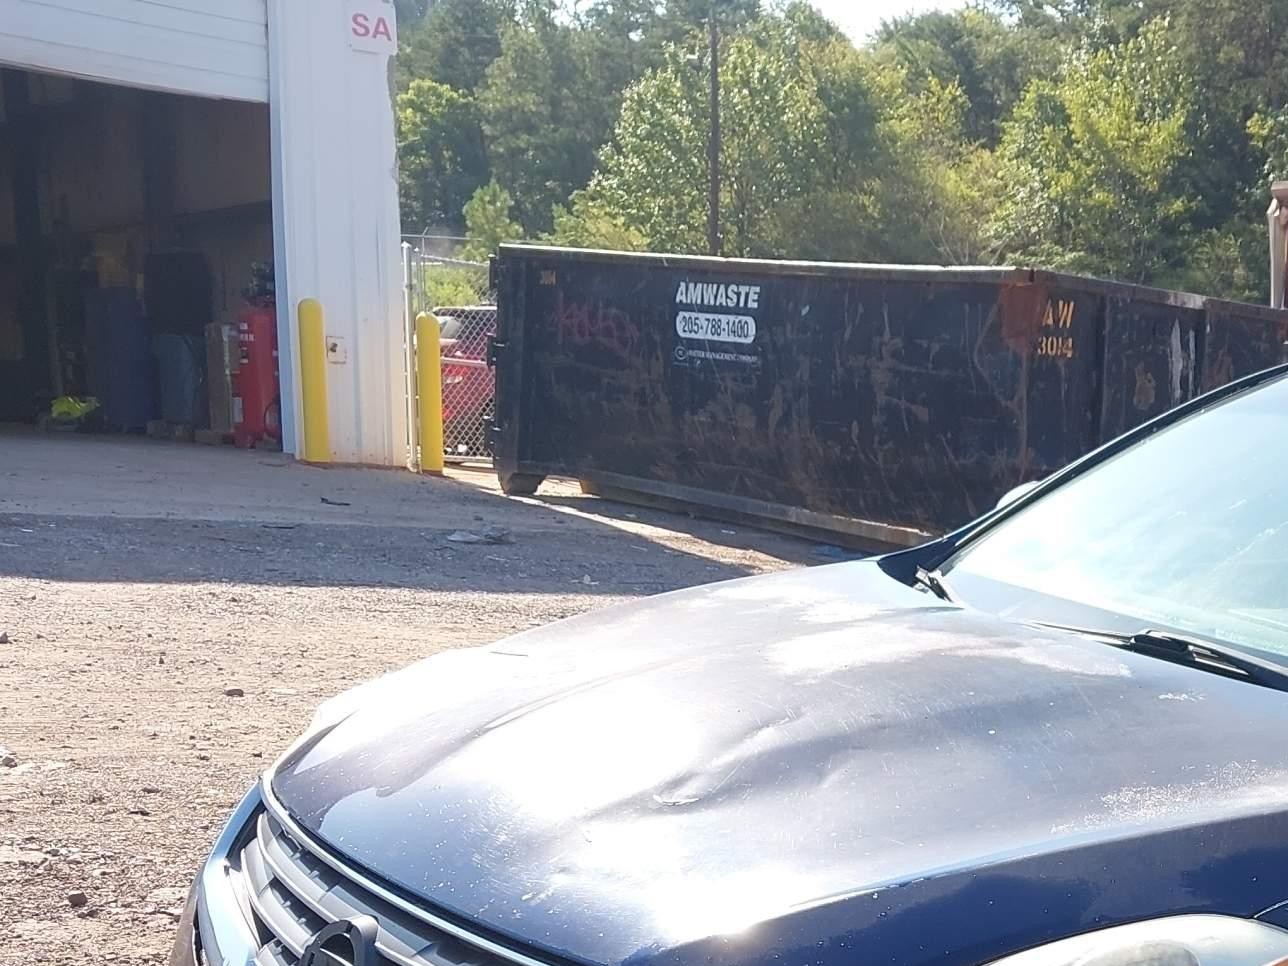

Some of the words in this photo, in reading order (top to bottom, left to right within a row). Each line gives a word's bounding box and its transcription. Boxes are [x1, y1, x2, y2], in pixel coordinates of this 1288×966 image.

[351, 12, 393, 41] SA
[675, 281, 761, 308] AMWASTE
[681, 315, 750, 338] 205-788-1400
[1037, 335, 1073, 358] 3014
